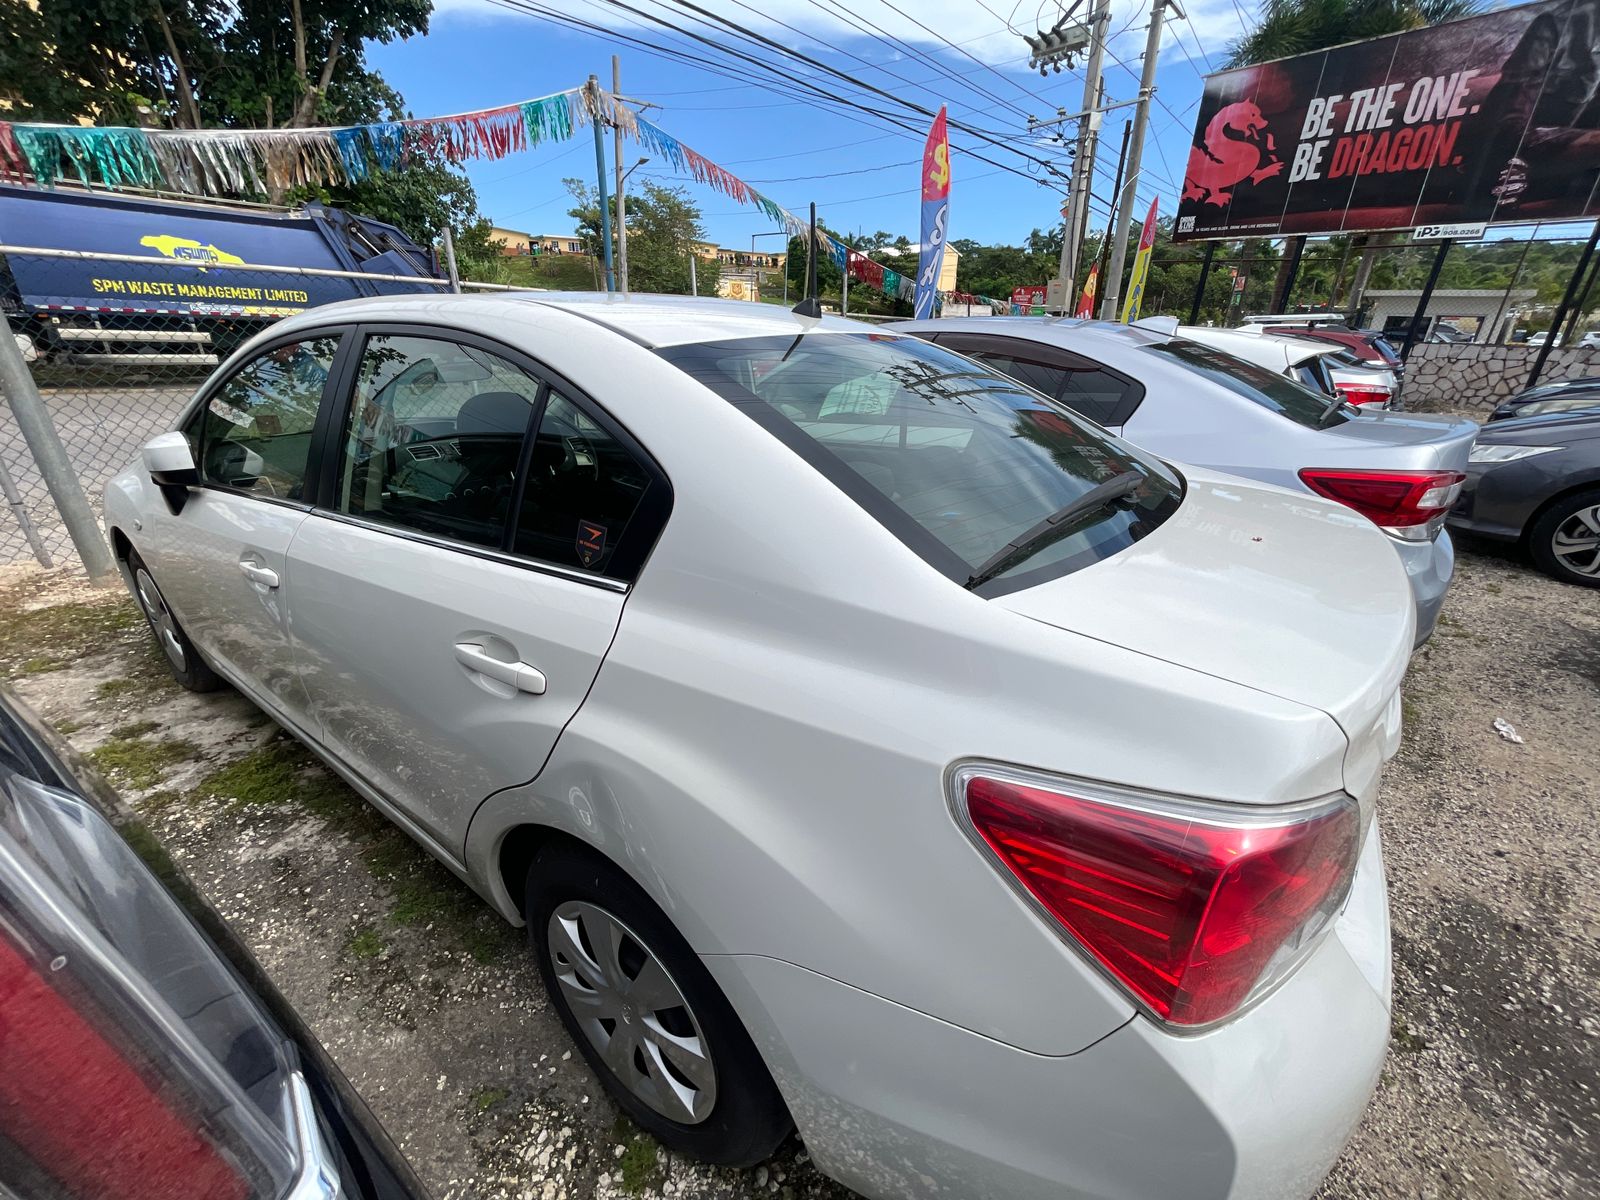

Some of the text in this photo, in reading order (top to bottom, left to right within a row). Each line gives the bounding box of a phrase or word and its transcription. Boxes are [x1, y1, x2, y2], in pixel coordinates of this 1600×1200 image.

[1300, 68, 1480, 140] BE THE ONE.
[1288, 121, 1464, 184] BE DRAGON.
[173, 246, 219, 262] NSWMA
[92, 278, 308, 303] SPM WASTE MANAGEMENT LIMITED
